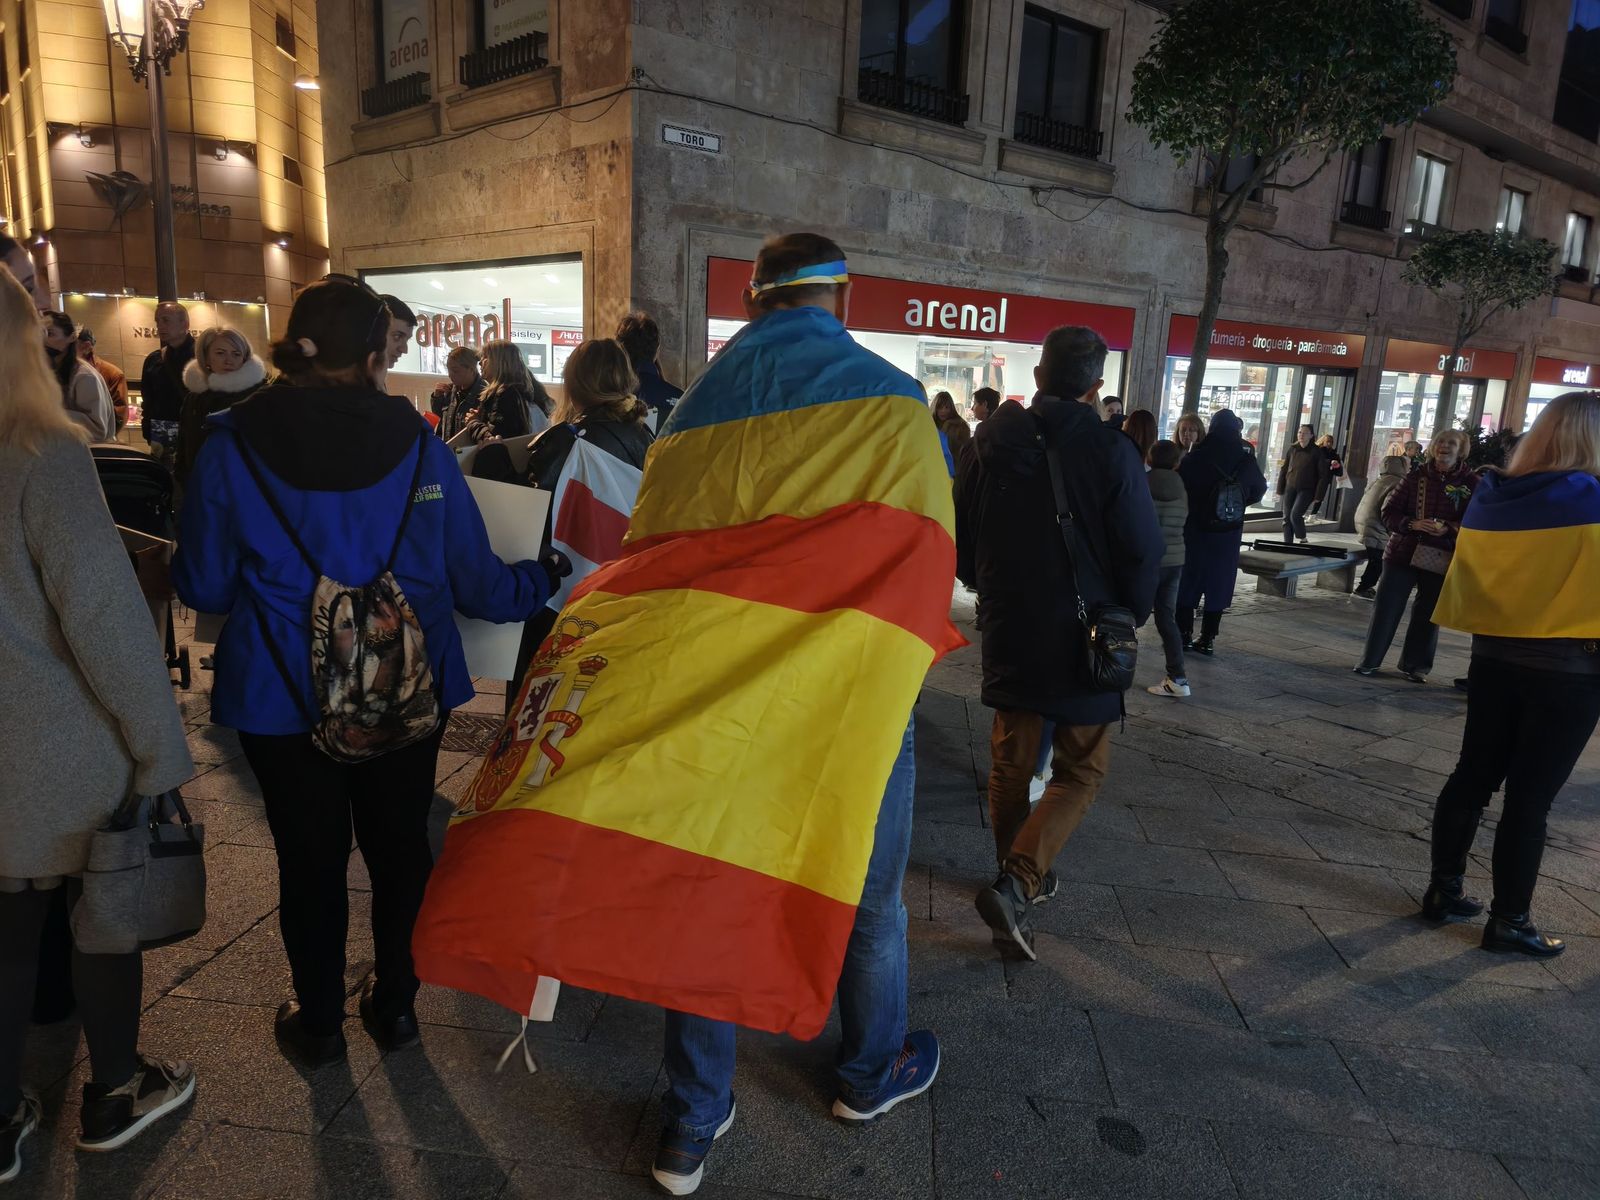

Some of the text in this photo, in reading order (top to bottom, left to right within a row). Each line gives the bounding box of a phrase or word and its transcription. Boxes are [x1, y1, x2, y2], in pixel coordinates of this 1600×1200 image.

[680, 132, 705, 147] TORO
[416, 298, 512, 349] arenal
[905, 297, 1008, 334] arenal
[510, 330, 543, 340] sisley
[1209, 329, 1348, 356] fumería droguería parafarmacia
